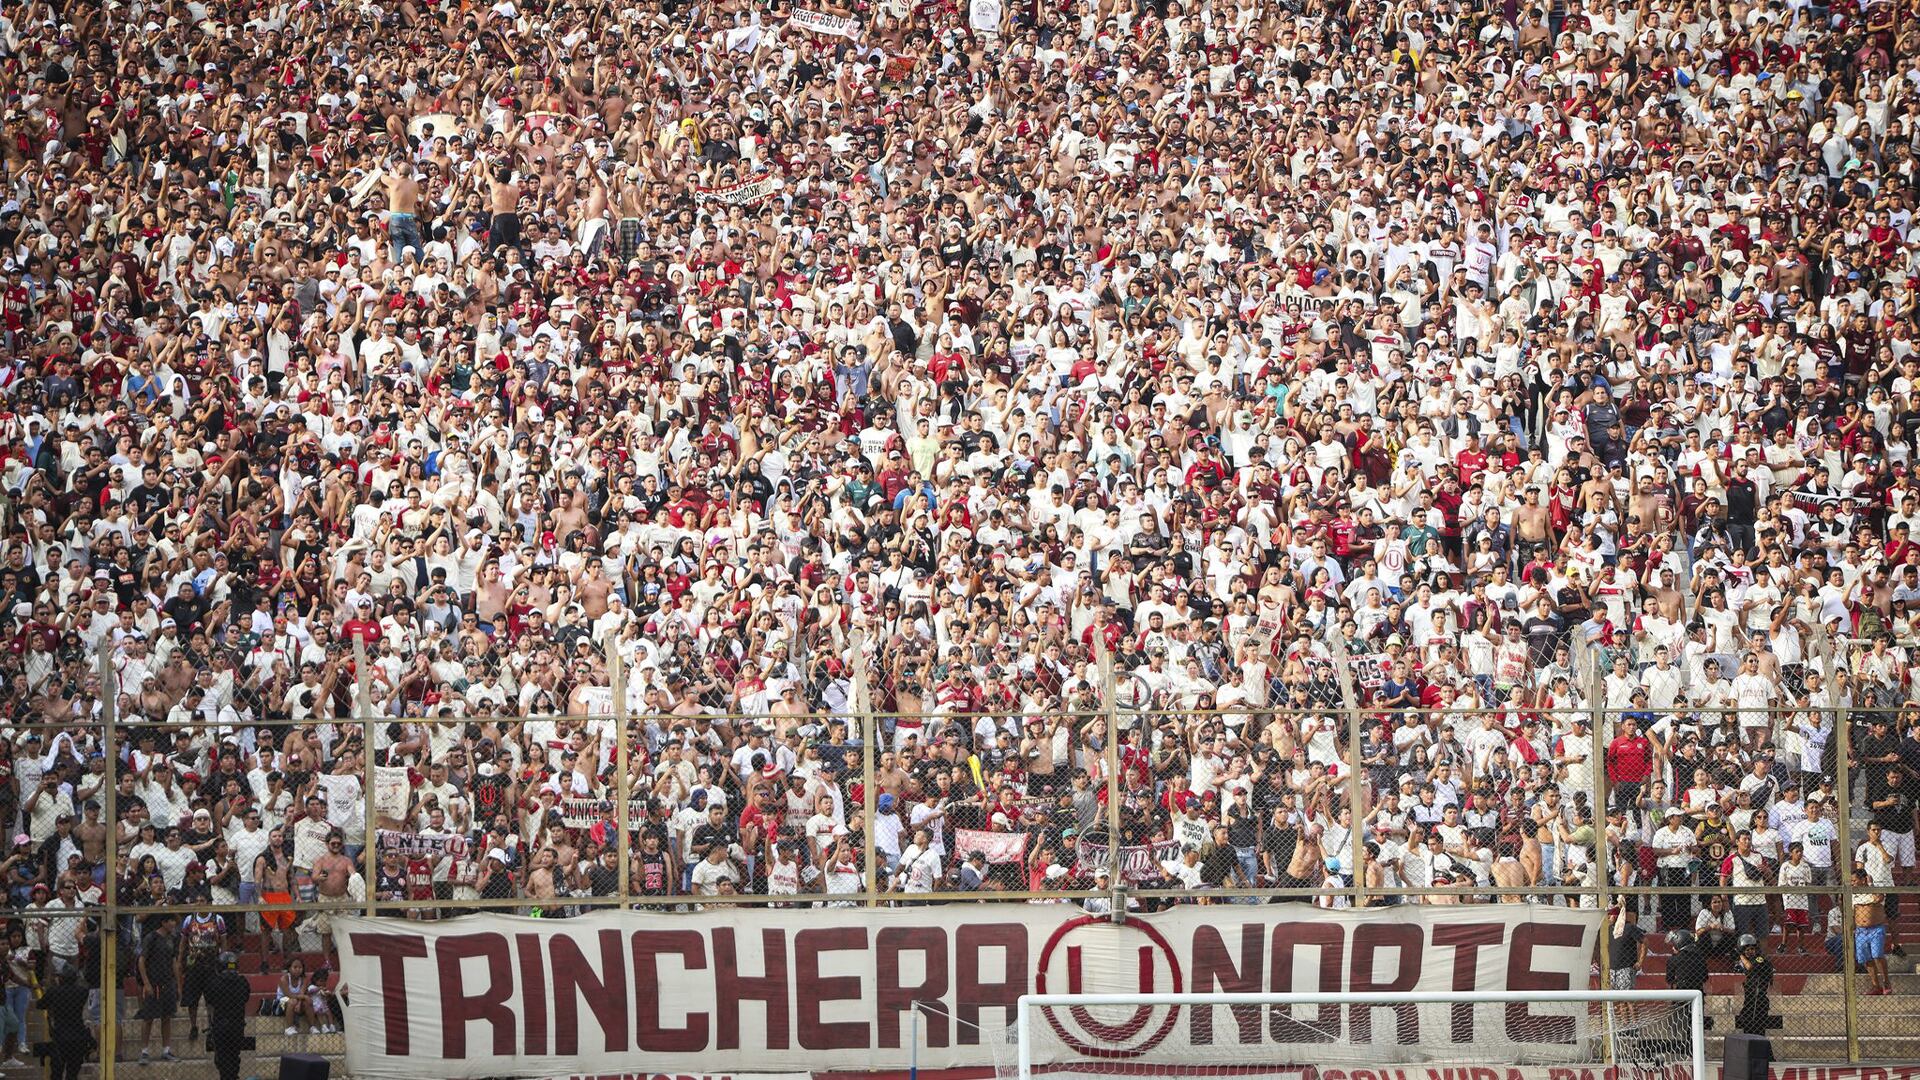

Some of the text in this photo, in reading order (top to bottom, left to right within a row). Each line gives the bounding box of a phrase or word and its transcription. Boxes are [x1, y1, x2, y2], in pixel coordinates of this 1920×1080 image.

[1285, 294, 1340, 312] CHACA
[563, 801, 602, 821] BUNKE
[645, 873, 663, 890] 23
[350, 921, 1585, 1060] TRINCHERA U NORTE
